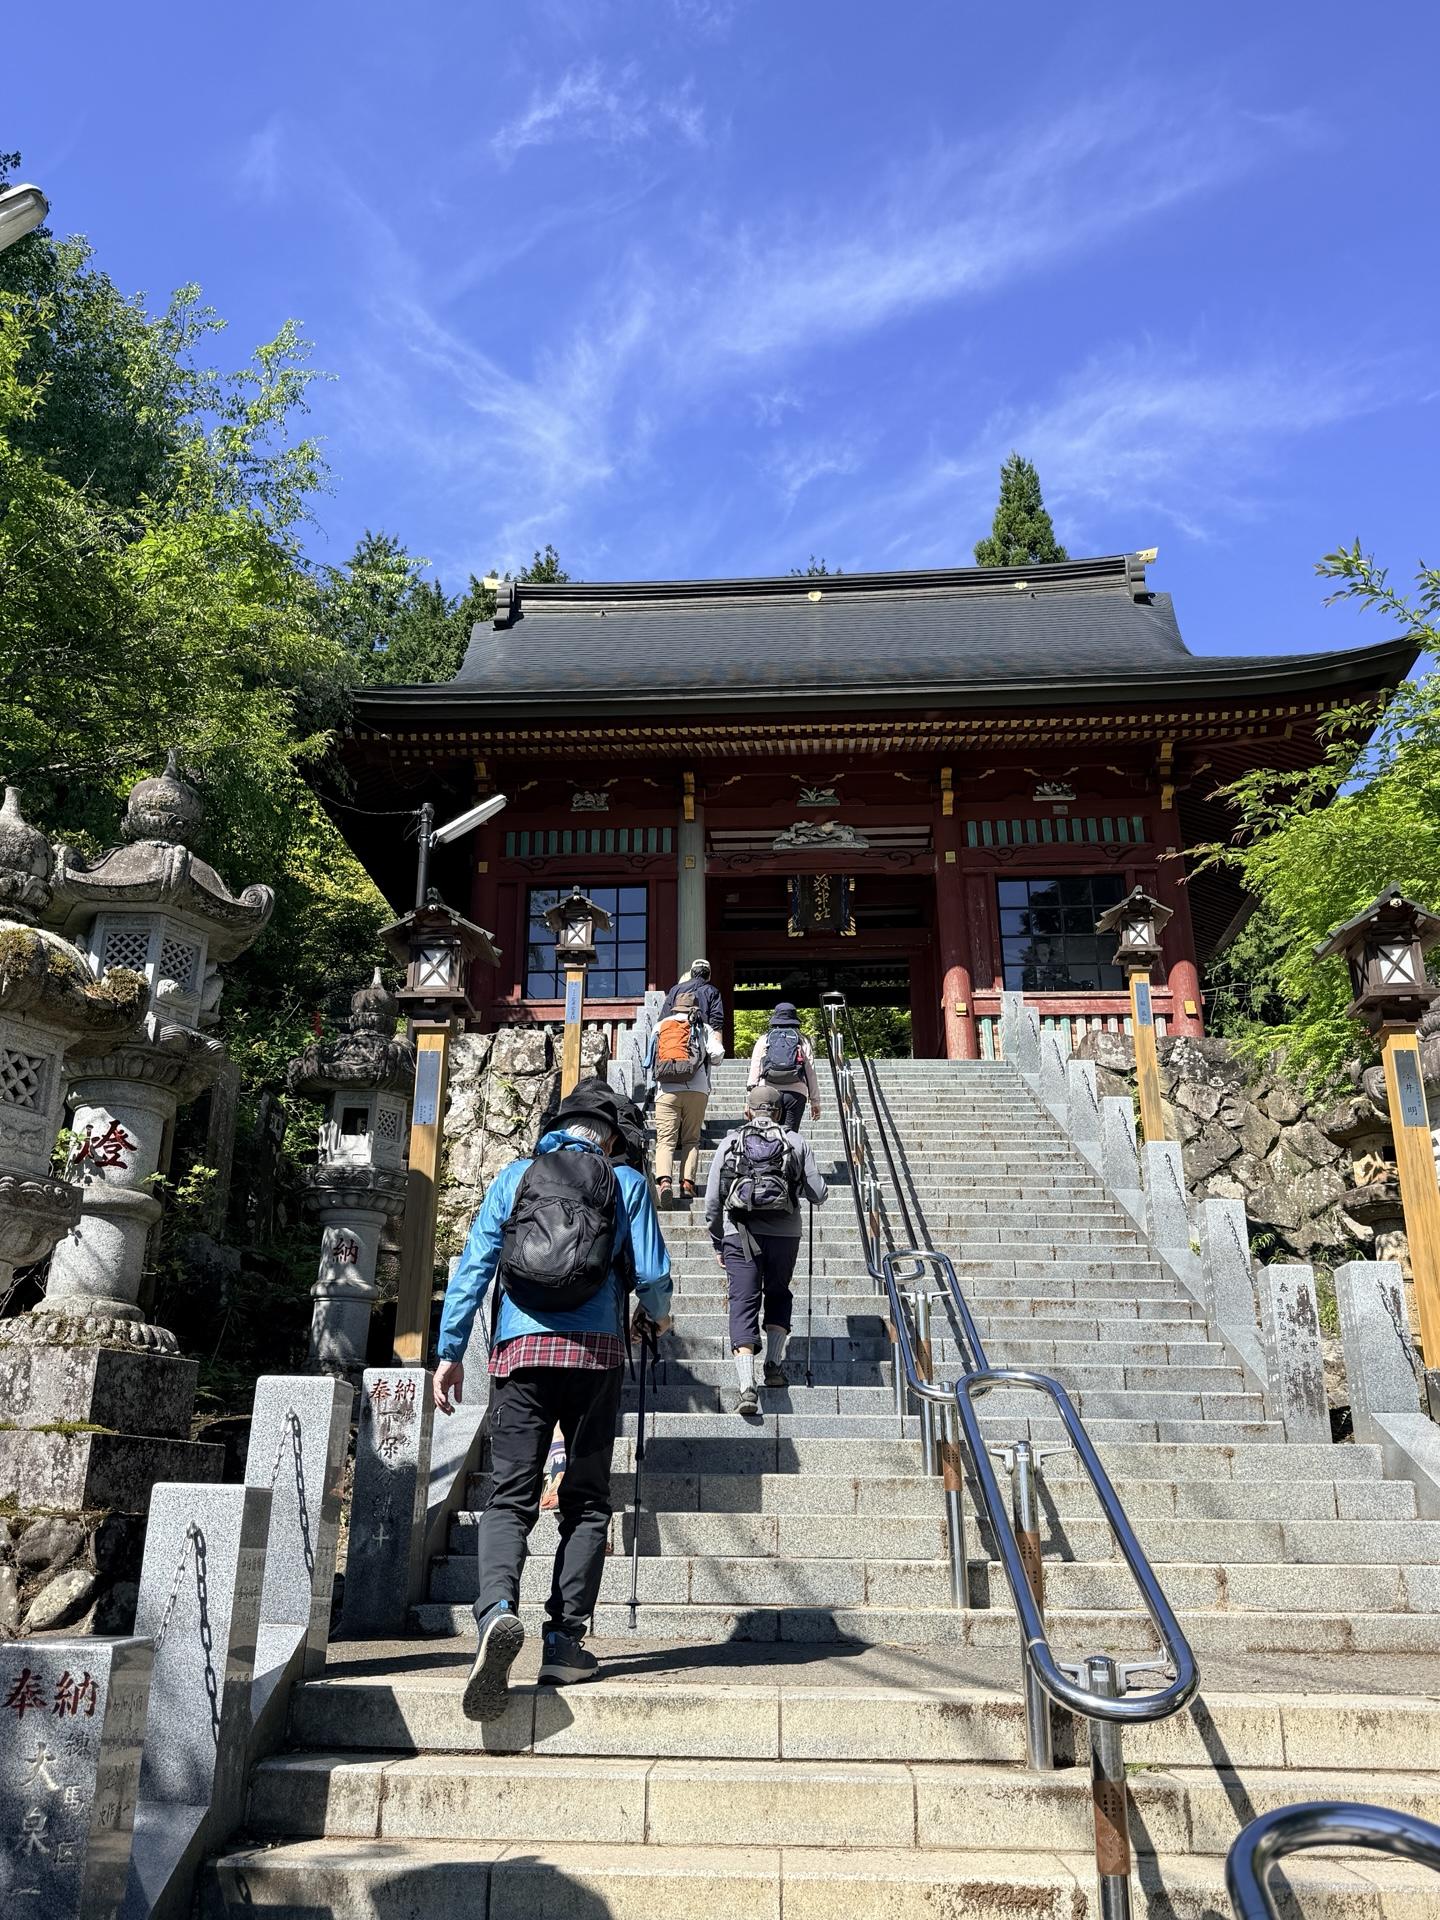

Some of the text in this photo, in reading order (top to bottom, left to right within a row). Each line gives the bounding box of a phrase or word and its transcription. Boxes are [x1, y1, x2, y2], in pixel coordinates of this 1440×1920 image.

[74, 1119, 137, 1169] 燈
[333, 1238, 359, 1264] 納
[369, 1378, 416, 1402] 奉納
[1, 1668, 99, 1718] 奉納
[53, 1730, 91, 1865] 練馬区
